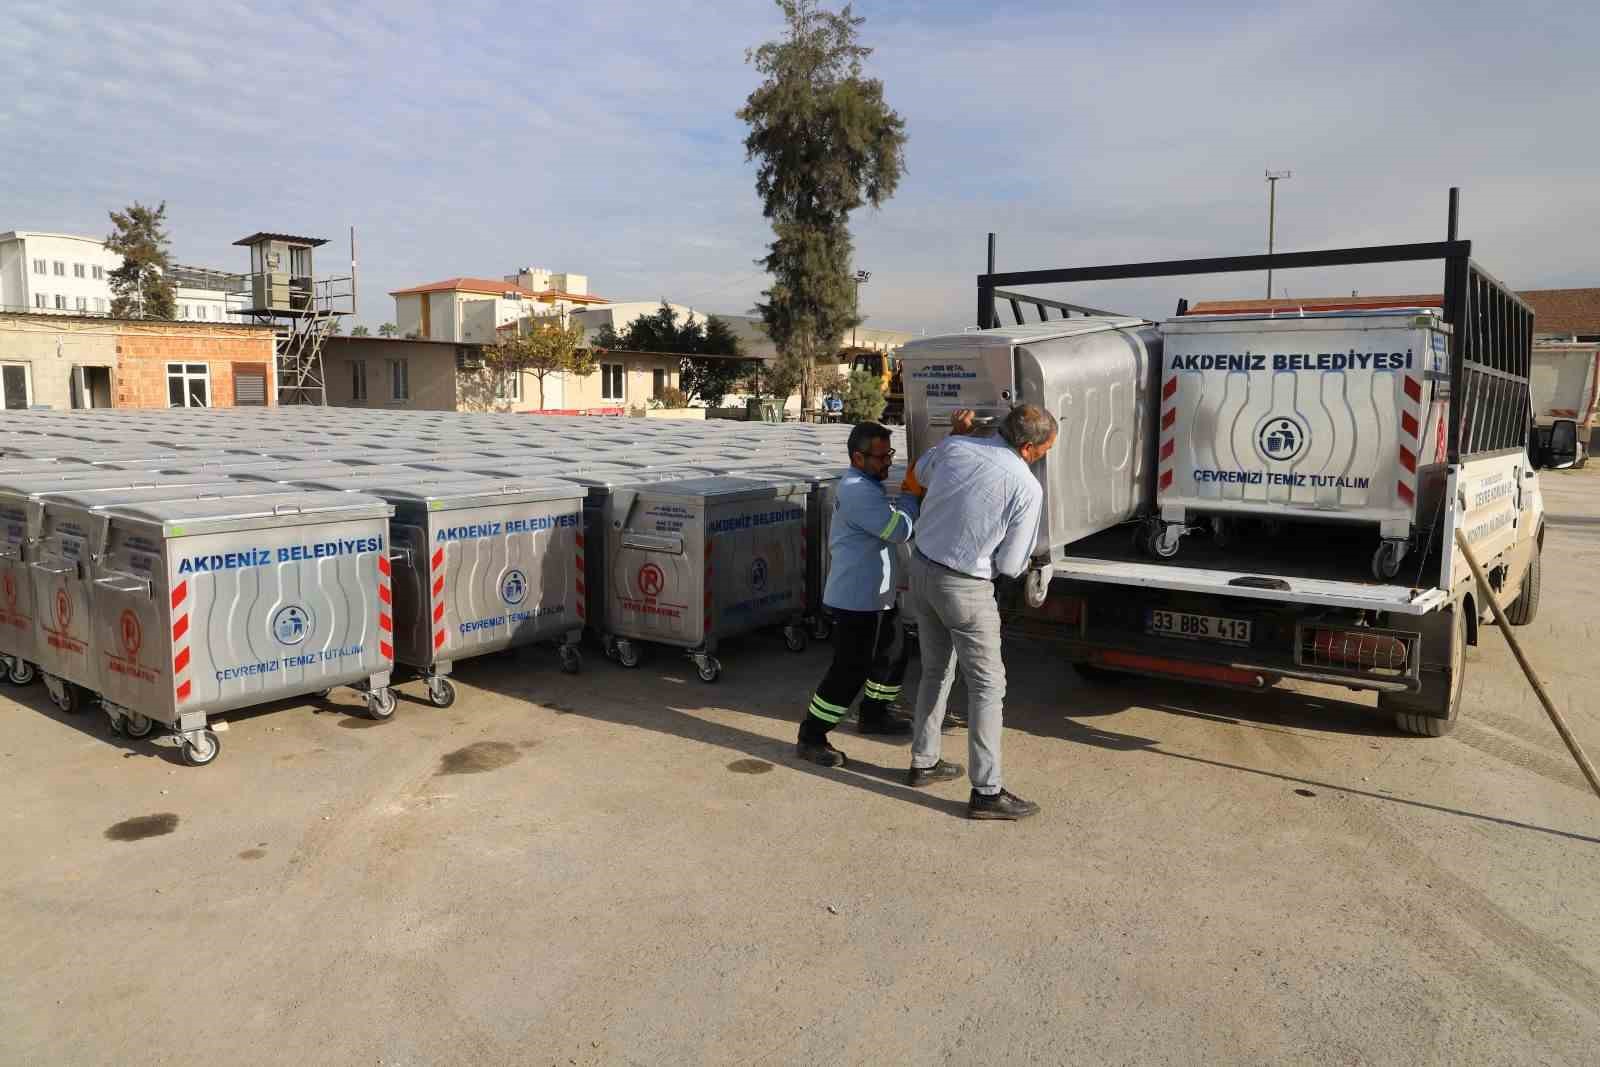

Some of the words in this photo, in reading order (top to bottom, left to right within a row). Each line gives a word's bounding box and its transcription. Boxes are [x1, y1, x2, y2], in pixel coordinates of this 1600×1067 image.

[1171, 351, 1266, 370] AKDENİZ
[1273, 349, 1413, 370] BELEDİYESİ
[1309, 474, 1370, 489] TUTALIM
[436, 520, 502, 541] AKDENİZ
[178, 547, 271, 574] AKDENİZ
[277, 533, 384, 562] BELEDİYESİ
[1153, 612, 1172, 630] 33
[1181, 615, 1208, 635] BBS
[1217, 620, 1248, 640] 413
